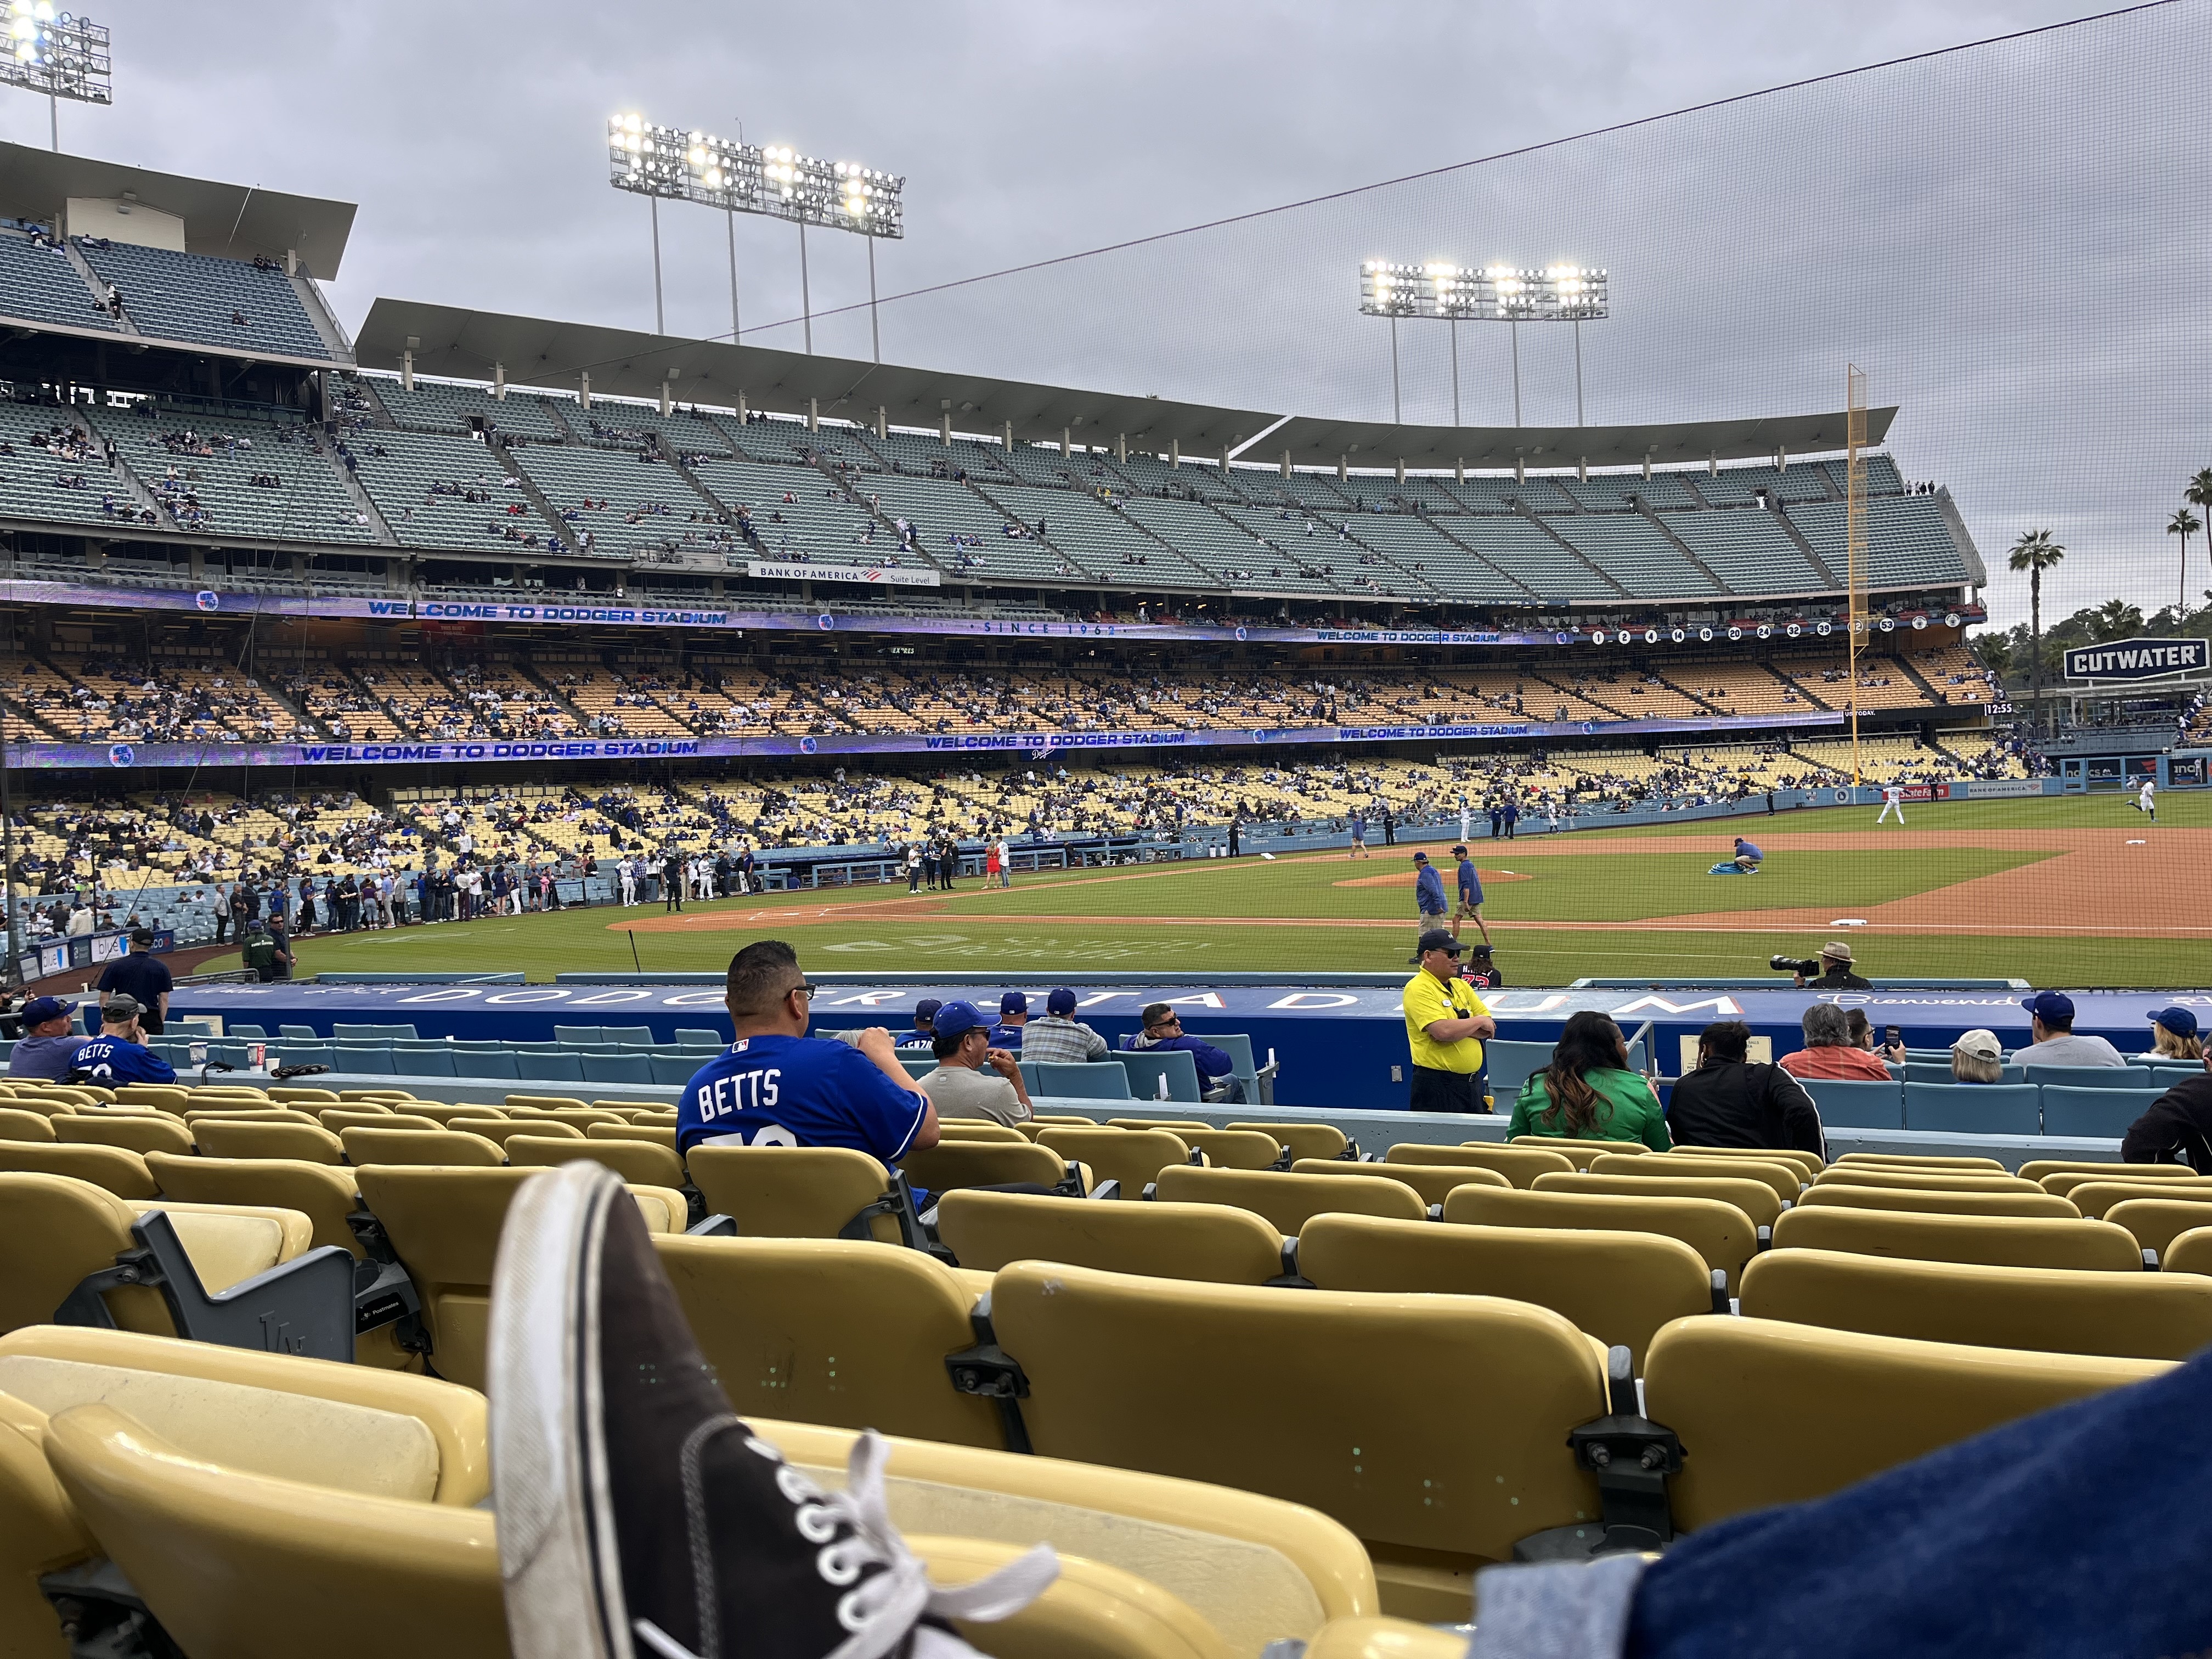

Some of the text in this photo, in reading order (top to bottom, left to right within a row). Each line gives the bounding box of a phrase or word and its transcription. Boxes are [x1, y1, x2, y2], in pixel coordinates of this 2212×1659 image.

[760, 568, 930, 584] BANK OF AMERICA Suite Level
[369, 602, 726, 624] WELCOME TO DODGER STADIUM
[985, 622, 1115, 635] SINCE 1962
[1788, 627, 1799, 635] 32
[1882, 621, 1892, 629] 53
[1317, 631, 1499, 642] WELCOME TO DODGER STADIUM
[2074, 645, 2196, 673] CUTWATER
[1987, 703, 2012, 714] 12:55
[1340, 726, 1527, 739] WELCOME TO DODGER STADIUM
[926, 733, 1184, 748] WELCOME TO DODGER STADIUM
[302, 742, 698, 761] WELCOME TO DODGER STADIUM
[98, 939, 119, 955] blue
[43, 950, 57, 967] blue
[978, 991, 1745, 1014] STADUM
[1817, 993, 2024, 1006] Bienvenid
[78, 1043, 114, 1061] BETTS
[698, 1069, 781, 1122] BETTS
[372, 1302, 399, 1315] Postmates
